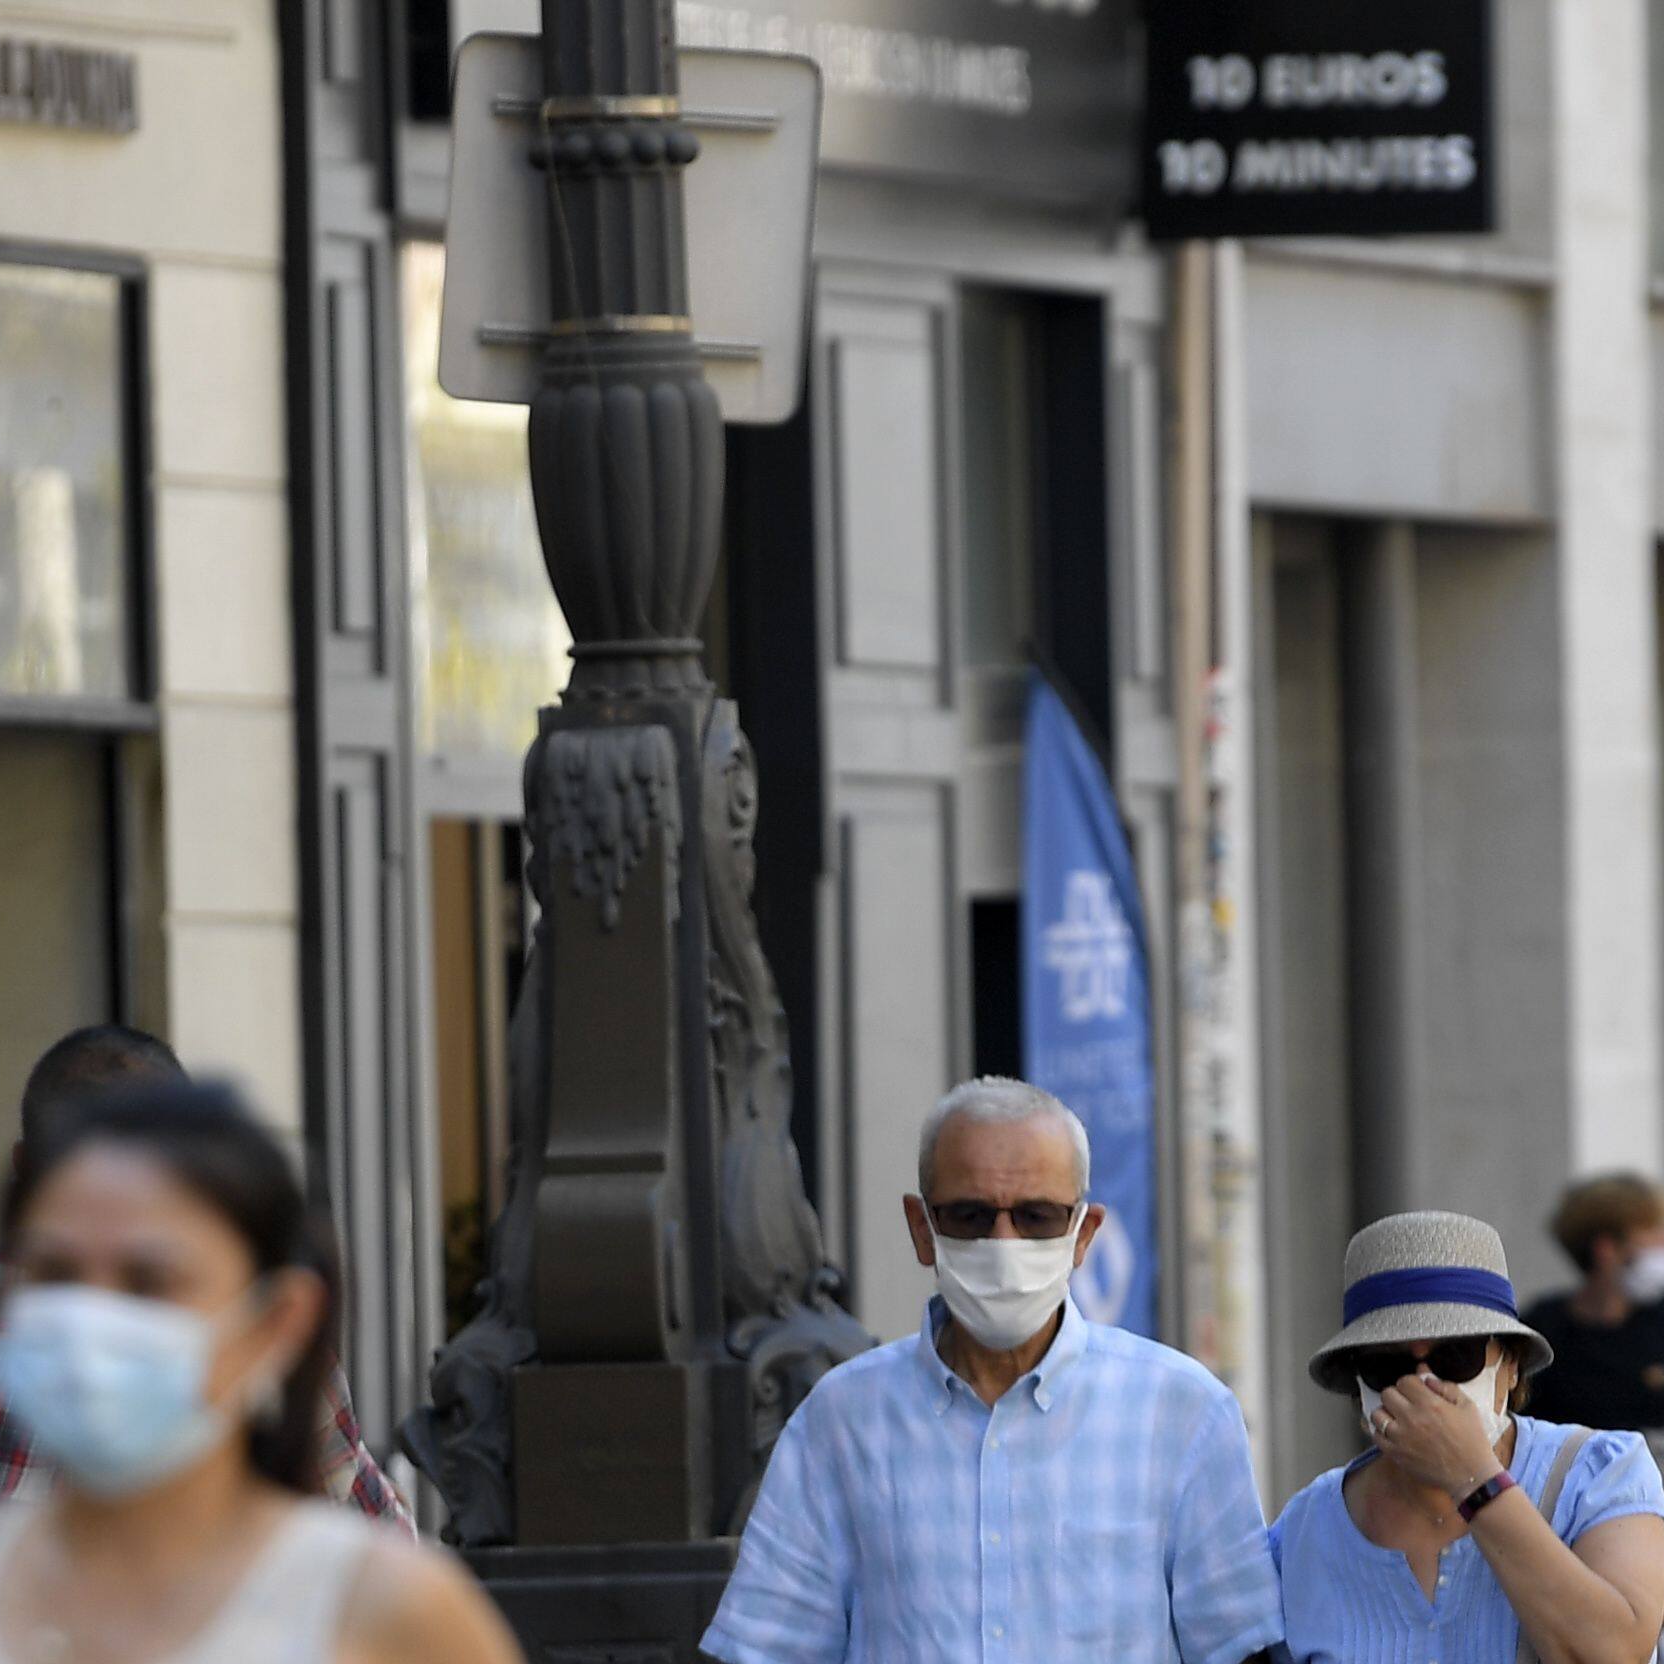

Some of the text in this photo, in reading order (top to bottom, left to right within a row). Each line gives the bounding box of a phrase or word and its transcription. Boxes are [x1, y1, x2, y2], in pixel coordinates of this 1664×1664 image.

[1188, 50, 1447, 107] 10 EUROS
[1158, 134, 1477, 194] 10 MINUTES
